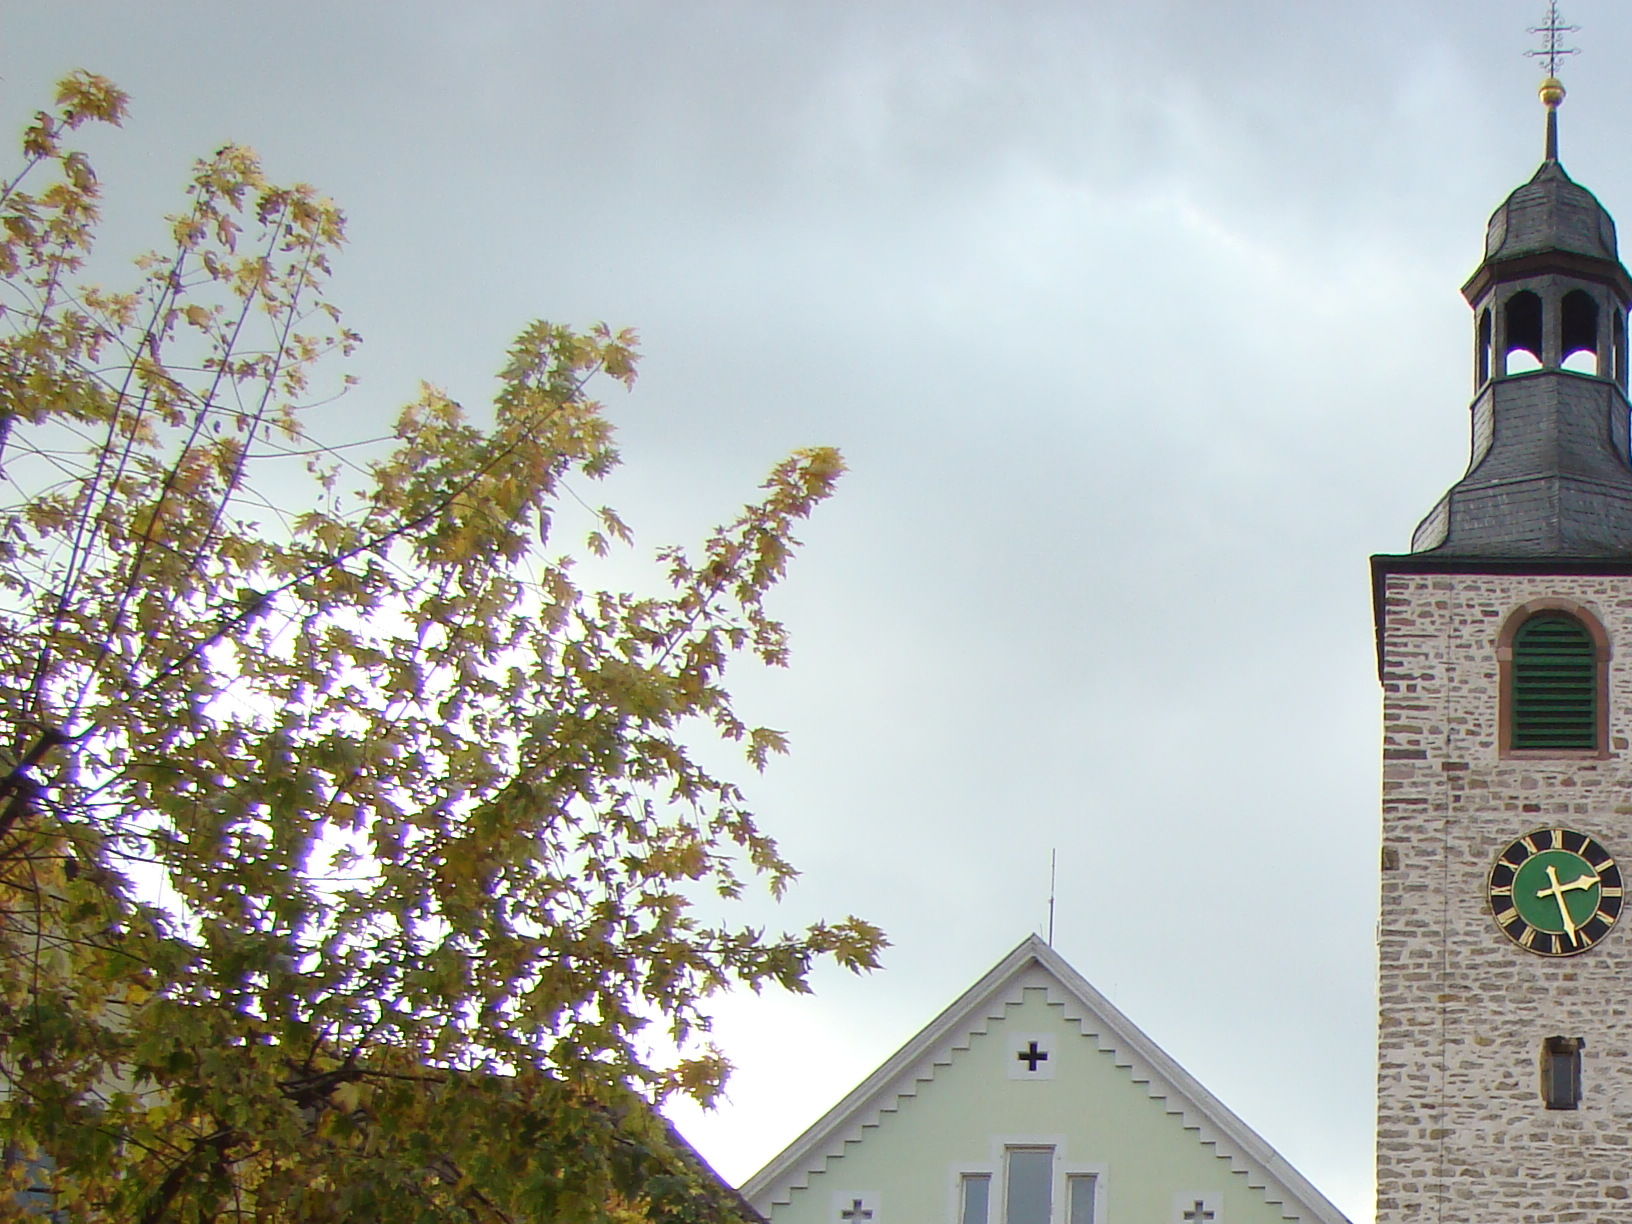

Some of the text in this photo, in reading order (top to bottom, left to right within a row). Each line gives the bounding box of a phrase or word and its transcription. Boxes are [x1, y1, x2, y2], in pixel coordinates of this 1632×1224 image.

[1520, 837, 1538, 856] XI
[1551, 830, 1563, 849] XII
[1578, 838, 1591, 855] I
[1498, 857, 1519, 873] X
[1594, 859, 1615, 873] II
[1491, 885, 1511, 896] IX
[1601, 887, 1622, 897] III
[1497, 907, 1519, 927] VIII
[1519, 926, 1537, 948] VII
[1551, 935, 1562, 954] VI
[1579, 930, 1592, 947] V
